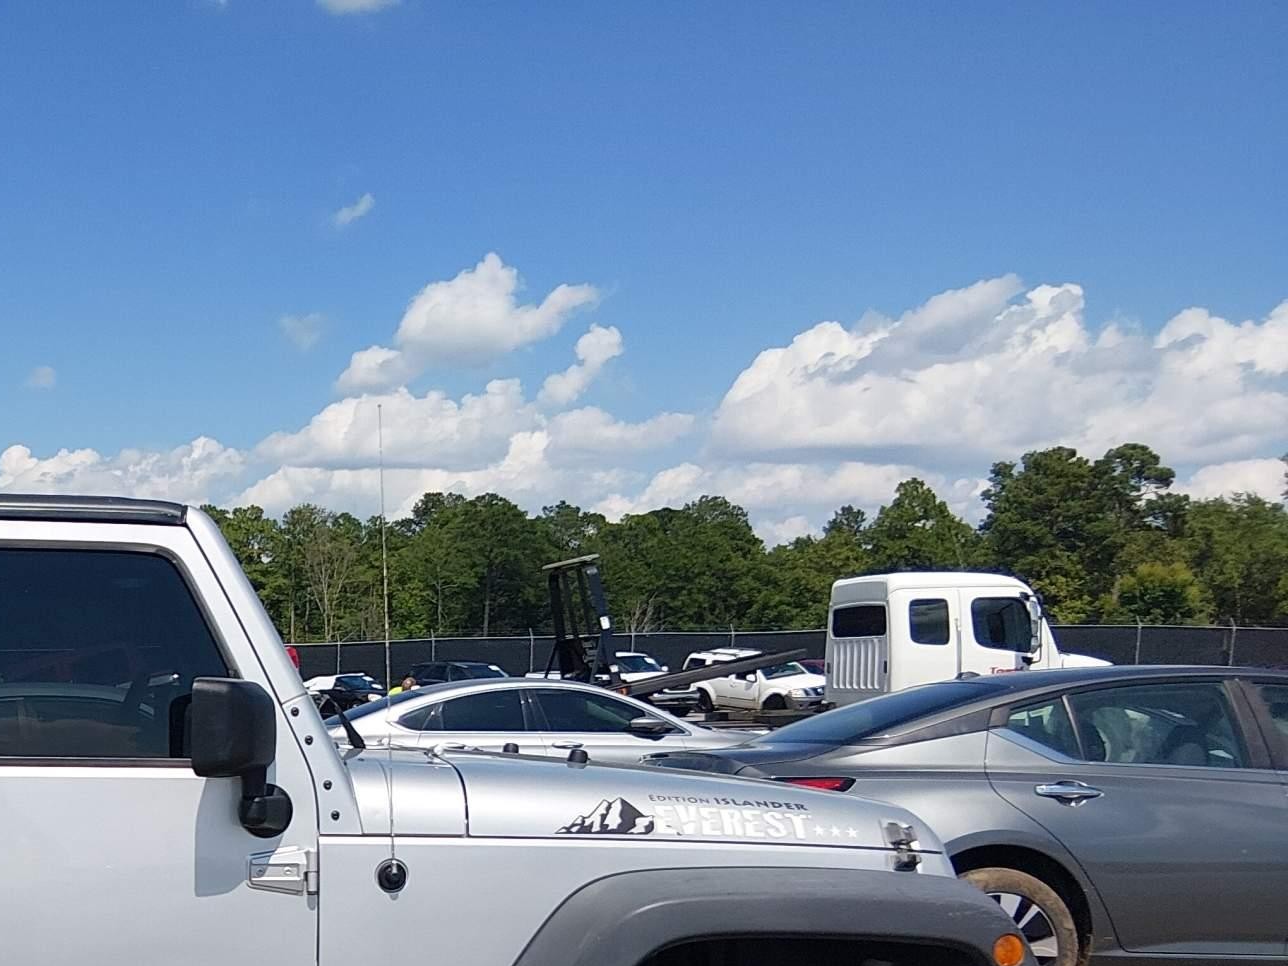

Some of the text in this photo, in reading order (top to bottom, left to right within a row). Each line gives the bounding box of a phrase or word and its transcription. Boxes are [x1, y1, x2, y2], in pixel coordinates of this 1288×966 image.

[648, 794, 808, 811] EDITION ISLANDER
[654, 805, 808, 839] EVEREST
